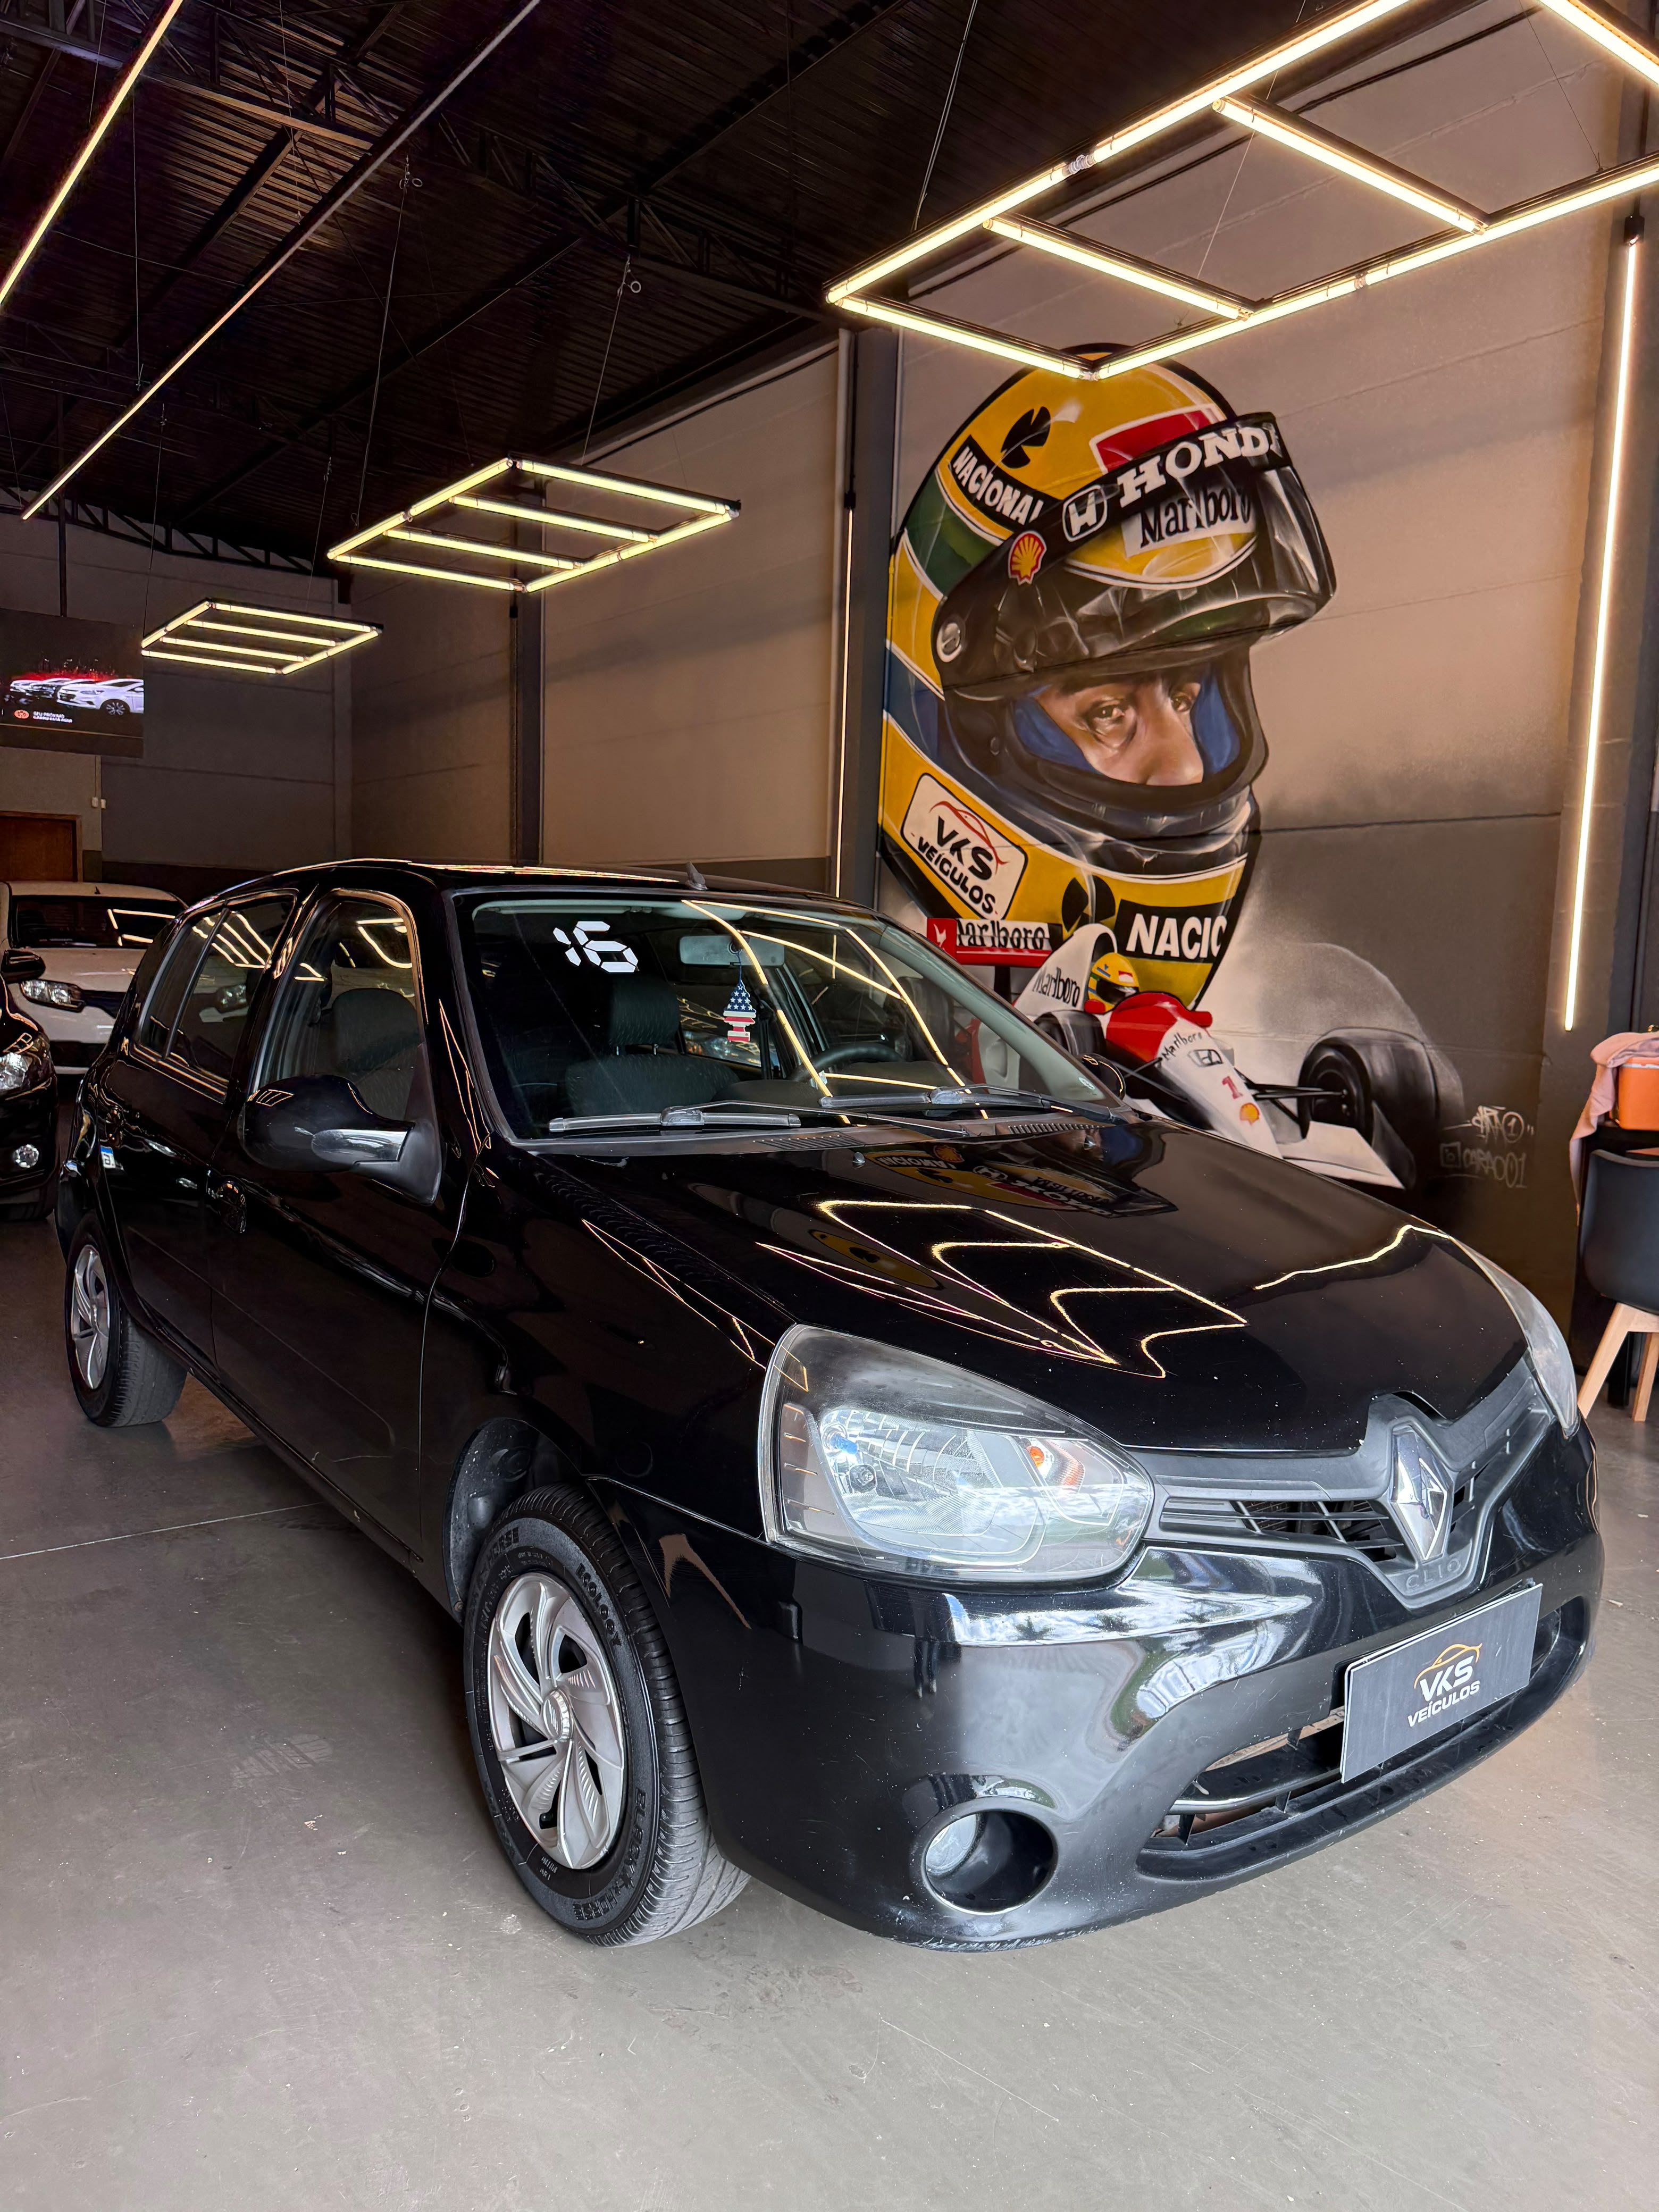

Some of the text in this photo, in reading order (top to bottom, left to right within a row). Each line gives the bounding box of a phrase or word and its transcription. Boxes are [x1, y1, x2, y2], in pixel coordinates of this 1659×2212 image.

[1140, 485, 1251, 548] Marlboro
[937, 815, 993, 881] VKS
[553, 920, 639, 973] 16
[1126, 912, 1227, 960] NACIO
[1033, 967, 1080, 1008] Marlboro
[1406, 1558, 1461, 1589] CLIO
[575, 1562, 622, 1647] ECOLOGY
[1420, 1655, 1474, 1702] VKS
[1407, 1680, 1480, 1728] VEÍCULOS
